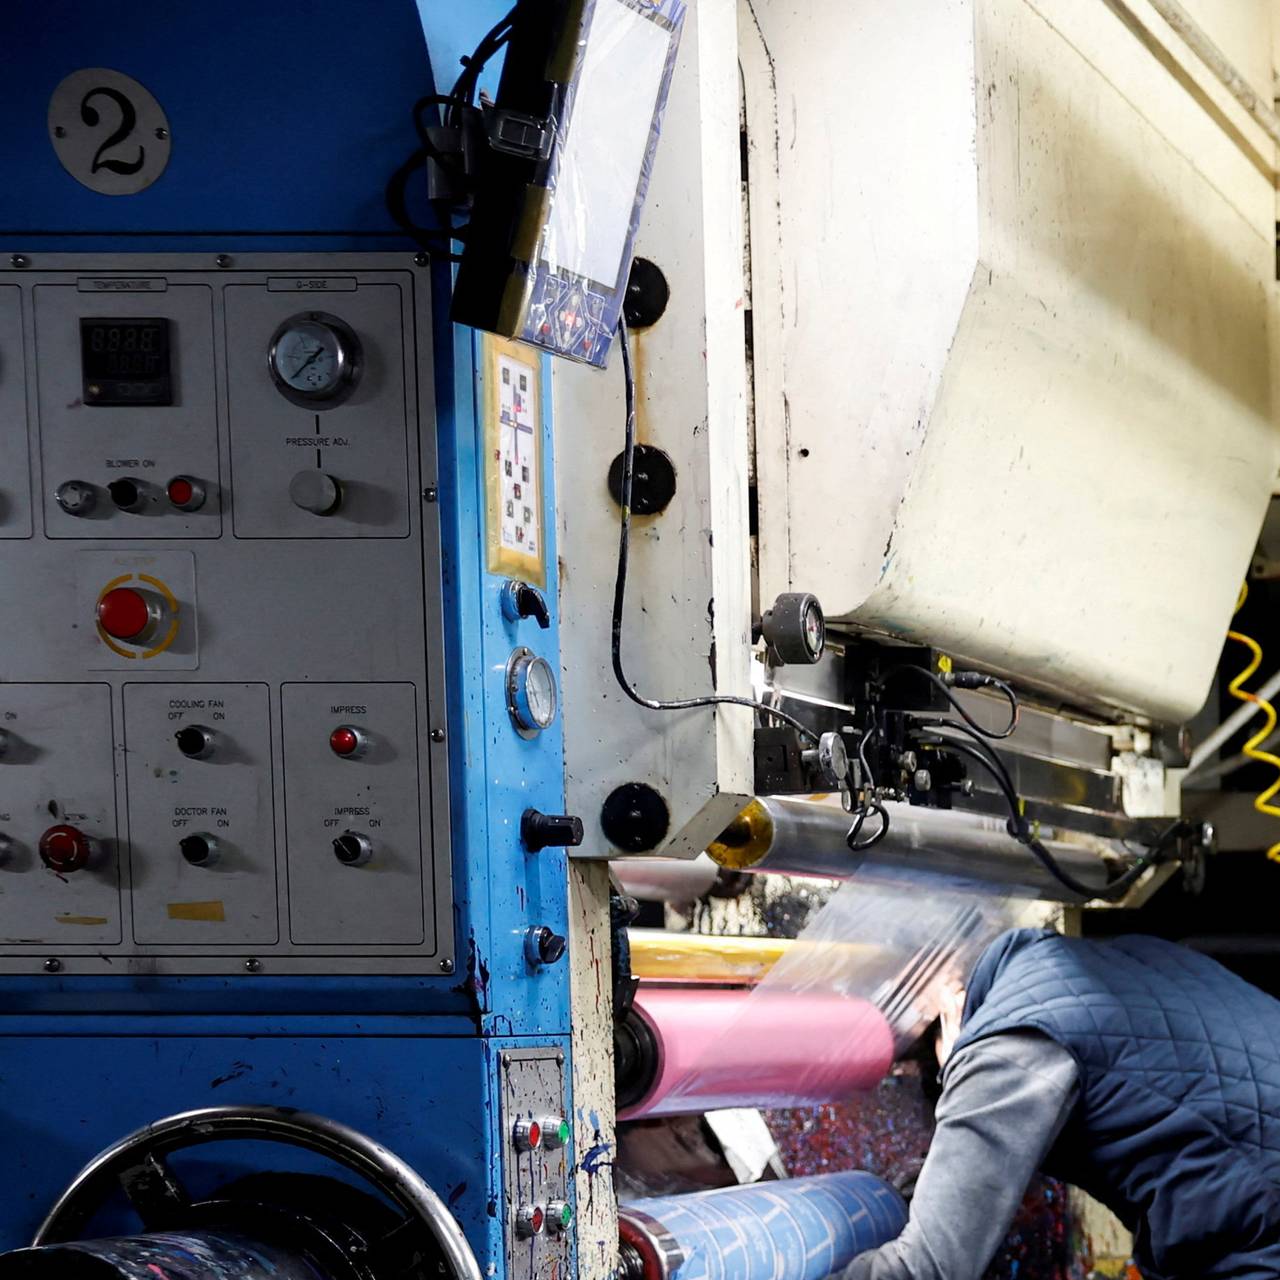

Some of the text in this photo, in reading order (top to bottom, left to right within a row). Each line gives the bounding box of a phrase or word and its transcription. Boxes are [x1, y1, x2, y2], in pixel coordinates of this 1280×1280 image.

[82, 87, 145, 175] 2
[285, 438, 330, 446] PRESSURE
[105, 460, 156, 468] BLOWER ON
[169, 700, 205, 708] COOLING
[330, 706, 367, 714] IMPRESS
[4, 712, 17, 720] ON
[167, 712, 225, 720] OFF ON
[173, 807, 228, 816] DOCTOR FAN
[171, 819, 230, 827] OFF ON
[323, 819, 340, 827] OFF
